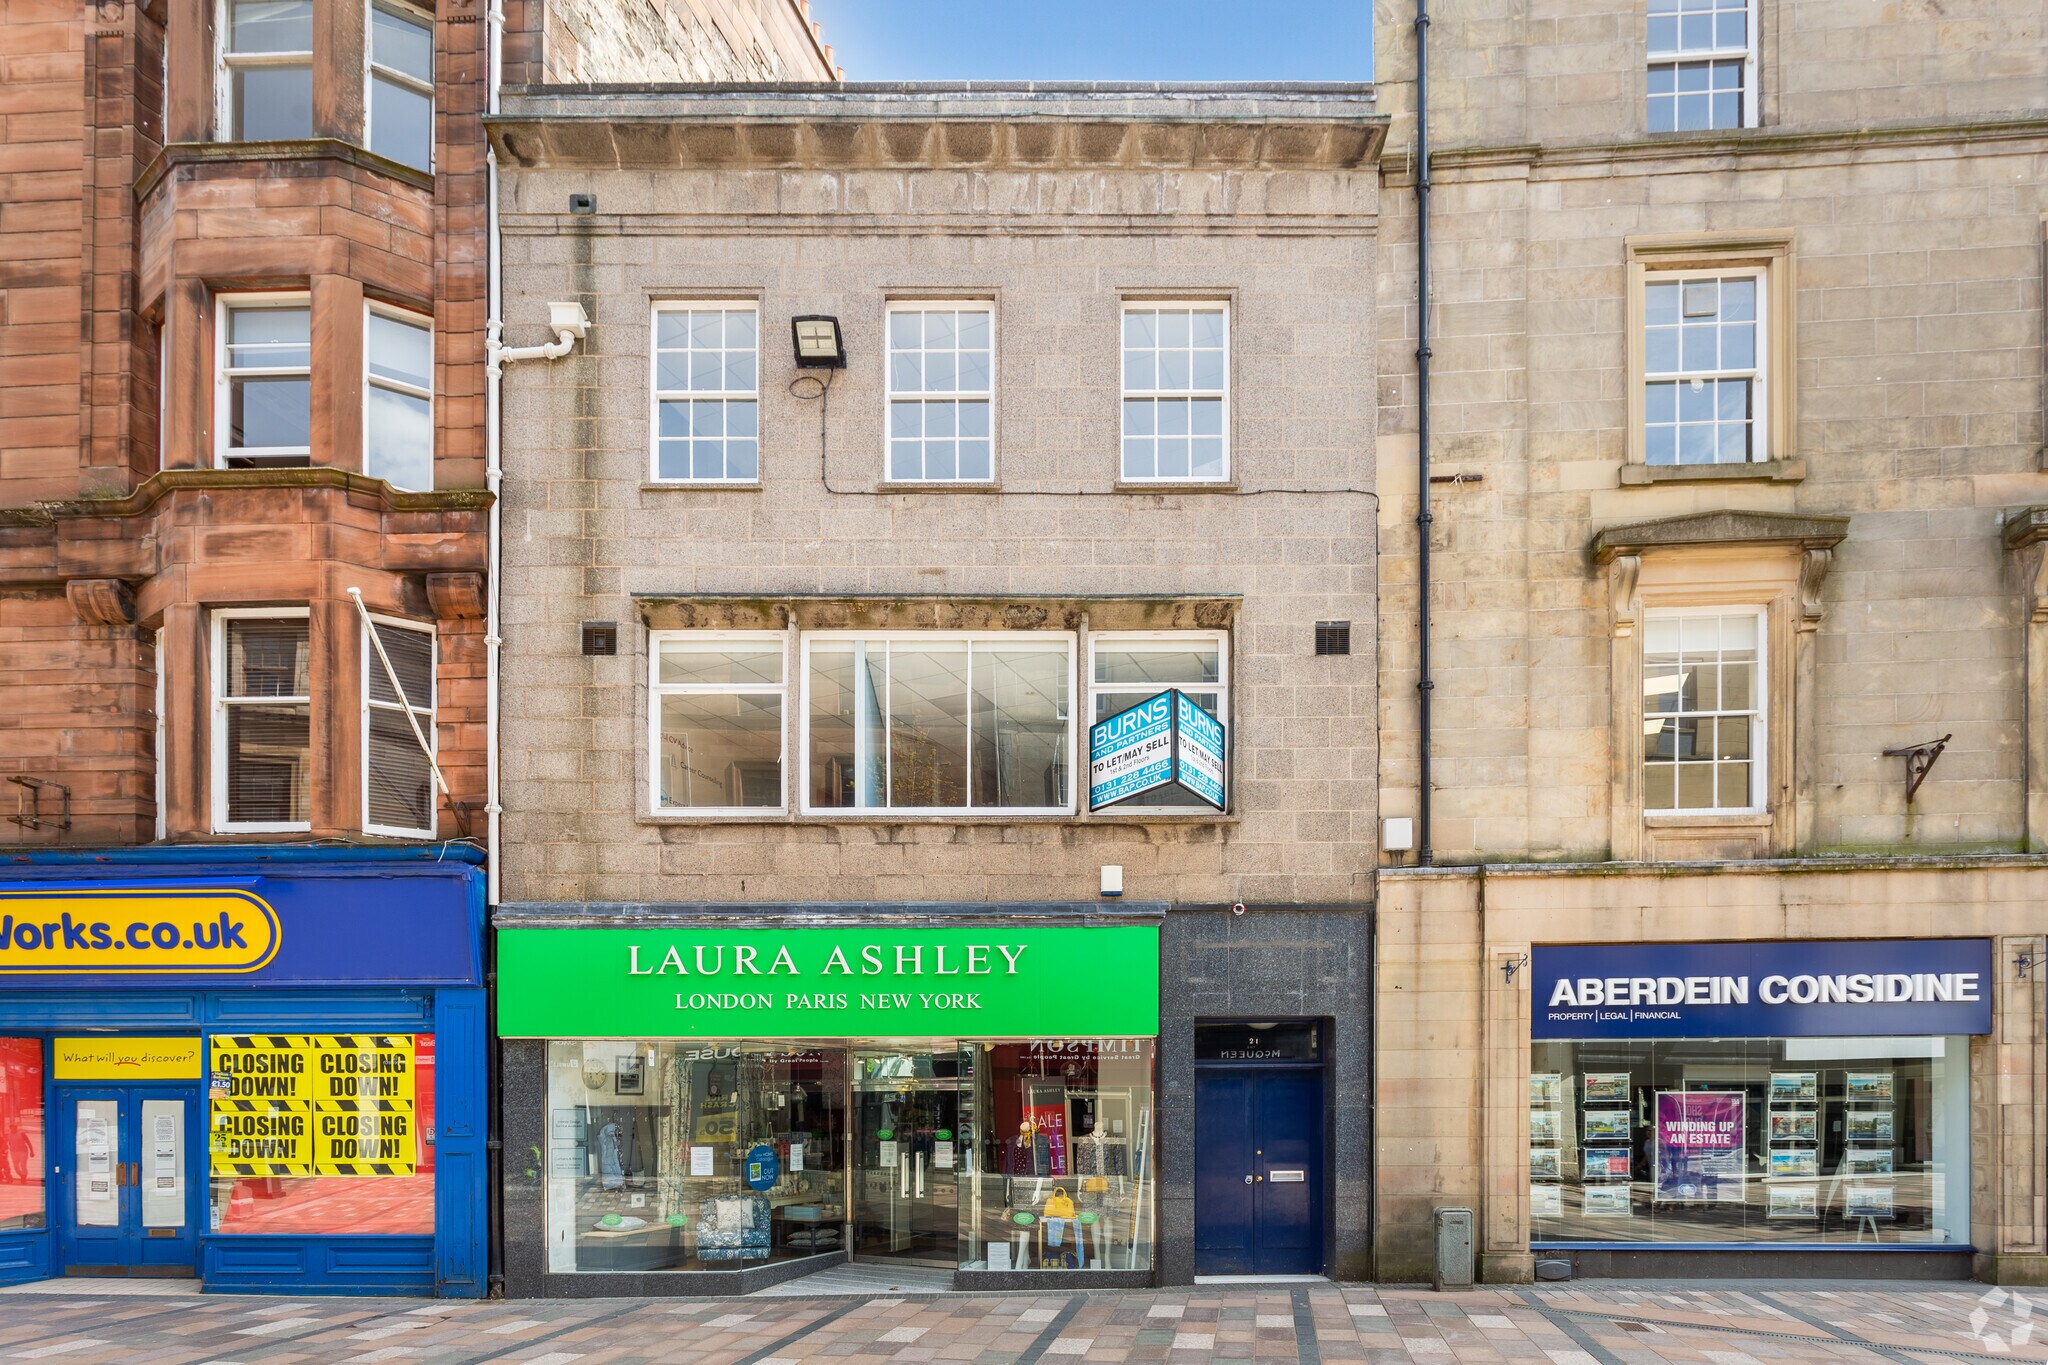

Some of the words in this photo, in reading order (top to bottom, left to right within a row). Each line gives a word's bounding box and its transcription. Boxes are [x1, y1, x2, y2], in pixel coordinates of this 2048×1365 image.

[1094, 698, 1167, 747] BURNS
[1179, 697, 1222, 746] BURNS
[1095, 744, 1114, 758] AND
[1116, 721, 1169, 749] PARTNERS
[1179, 737, 1187, 749] TO
[1180, 724, 1193, 737] AND
[1194, 732, 1222, 758] PARTNERS
[1093, 762, 1105, 774] TO
[1106, 746, 1144, 769] LET/MAY
[1146, 736, 1169, 752] SELL
[1123, 761, 1133, 771] 2nd
[1134, 755, 1150, 766] Floors
[1095, 780, 1117, 793] 0131
[1120, 772, 1140, 785] 228
[1143, 760, 1169, 777] 4466
[1180, 761, 1195, 777] 0131
[1096, 773, 1162, 803] WWW.BAP.CO.UK
[0, 911, 248, 951] orks.co.uk
[627, 945, 799, 976] LAURA
[822, 944, 1028, 976] ASHLEY
[1548, 976, 1749, 1008] ABERDEIN
[1758, 972, 1979, 1005] CONSIDINE
[675, 993, 774, 1010] LONDON
[785, 993, 848, 1010] PARIS
[859, 993, 912, 1010] NEW
[919, 993, 982, 1010] YORK
[1548, 1012, 1593, 1021] PROPERTY
[1600, 1012, 1629, 1020] LEGAL
[1634, 1011, 1681, 1020] FINANCIAL
[64, 1052, 94, 1063] What
[97, 1052, 115, 1063] will
[117, 1054, 138, 1065] you
[141, 1050, 195, 1063] discover?
[218, 1054, 304, 1074] CLOSING
[320, 1054, 406, 1074] CLOSING
[211, 1080, 231, 1089] £1.50
[229, 1076, 296, 1096] DOWN!
[330, 1076, 399, 1096] DOWN!
[220, 1116, 304, 1136] CLOSING
[322, 1116, 407, 1136] CLOSING
[1029, 1114, 1063, 1128] SALE
[1666, 1121, 1716, 1132] WINDING
[1719, 1121, 1735, 1132] UP
[228, 1138, 296, 1159] DOWN!
[330, 1138, 400, 1159] DOWN!
[1670, 1134, 1687, 1144] AN
[1690, 1134, 1731, 1144] ESTATE
